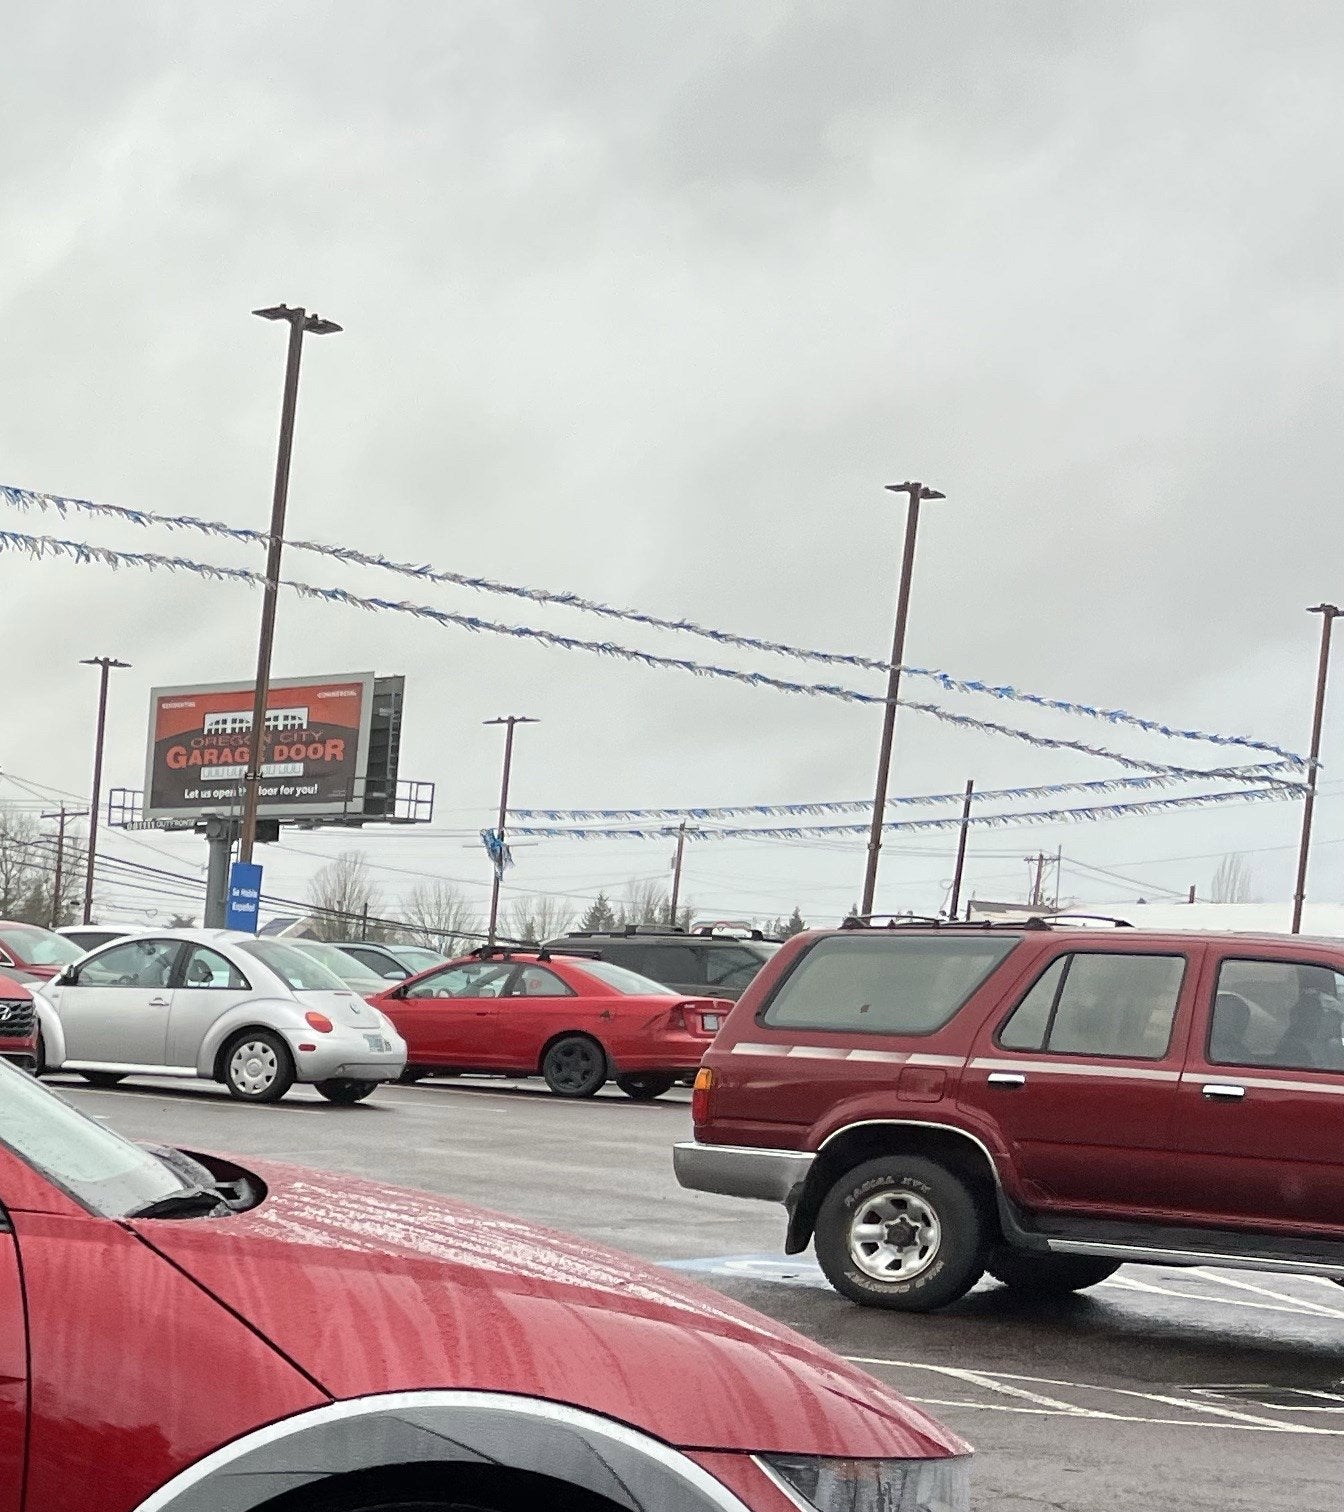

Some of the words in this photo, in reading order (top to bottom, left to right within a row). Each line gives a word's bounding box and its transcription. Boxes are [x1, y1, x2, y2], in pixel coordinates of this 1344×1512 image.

[280, 730, 325, 743] CITY
[166, 746, 266, 769] GARAG
[274, 738, 345, 762] DOOR
[184, 788, 199, 799] Let
[200, 790, 211, 799] us
[212, 789, 237, 800] open
[279, 784, 294, 795] for
[295, 783, 318, 797] you!
